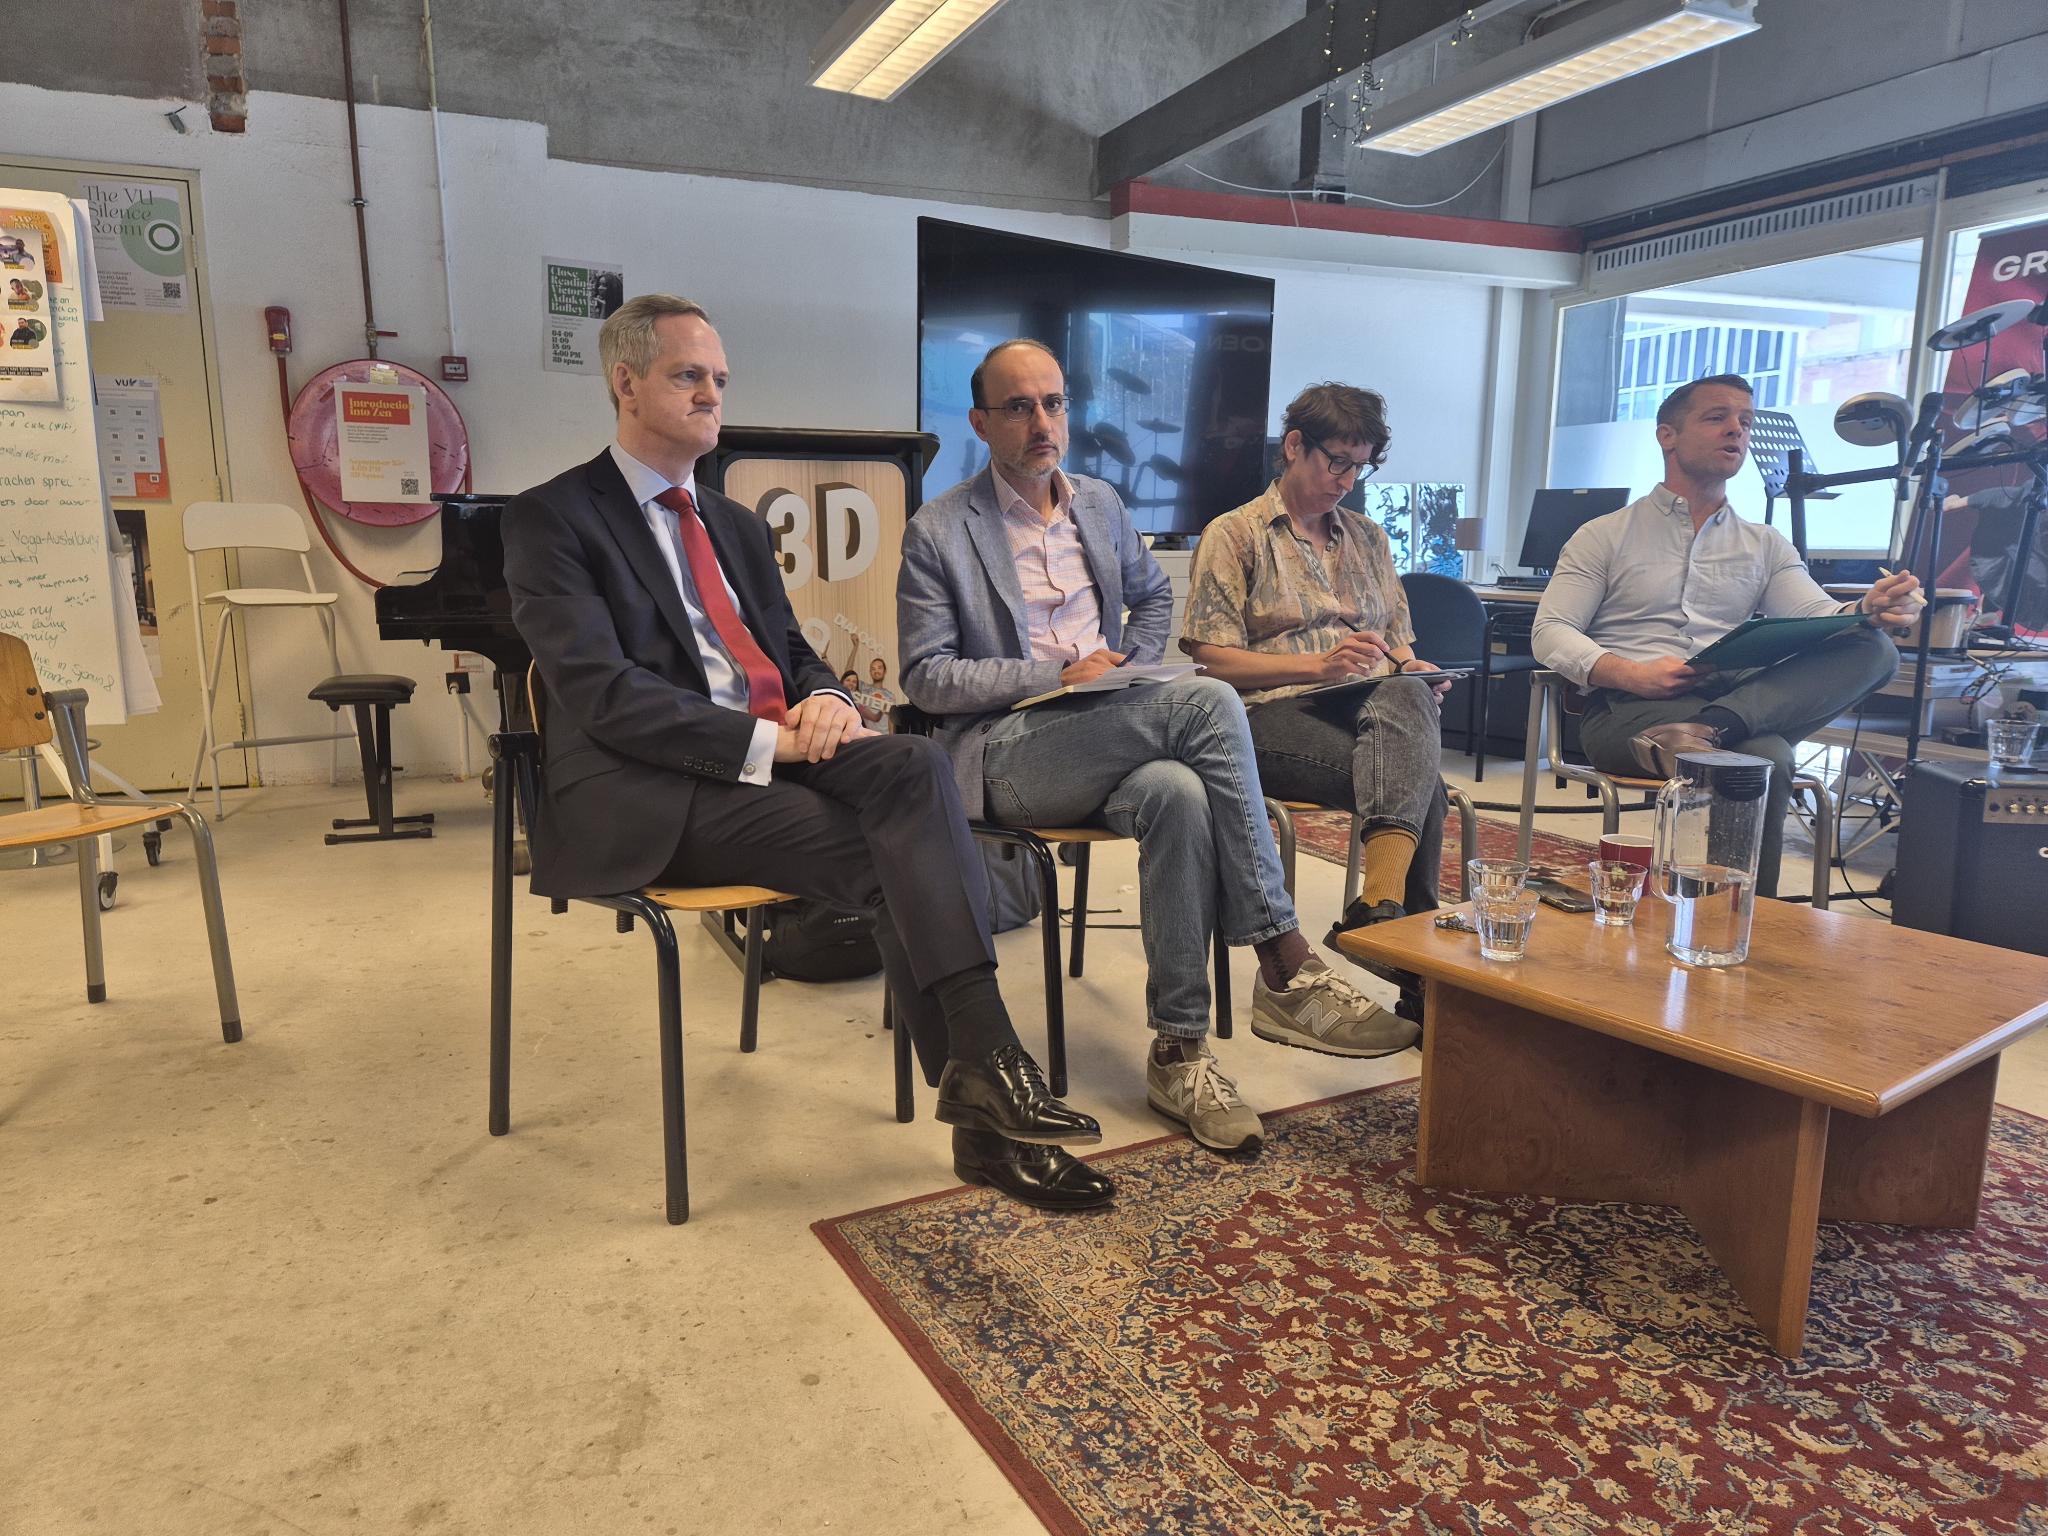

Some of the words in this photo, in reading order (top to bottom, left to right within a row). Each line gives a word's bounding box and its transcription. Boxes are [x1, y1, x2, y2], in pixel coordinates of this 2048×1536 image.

[83, 185, 118, 202] The
[124, 188, 153, 205] VU
[89, 201, 152, 220] Silence
[551, 266, 579, 278] Close
[1992, 250, 2048, 282] GR
[349, 398, 416, 410] Introduction
[372, 407, 393, 417] Zen
[756, 482, 880, 593] 3D
[1296, 998, 1342, 1038] N
